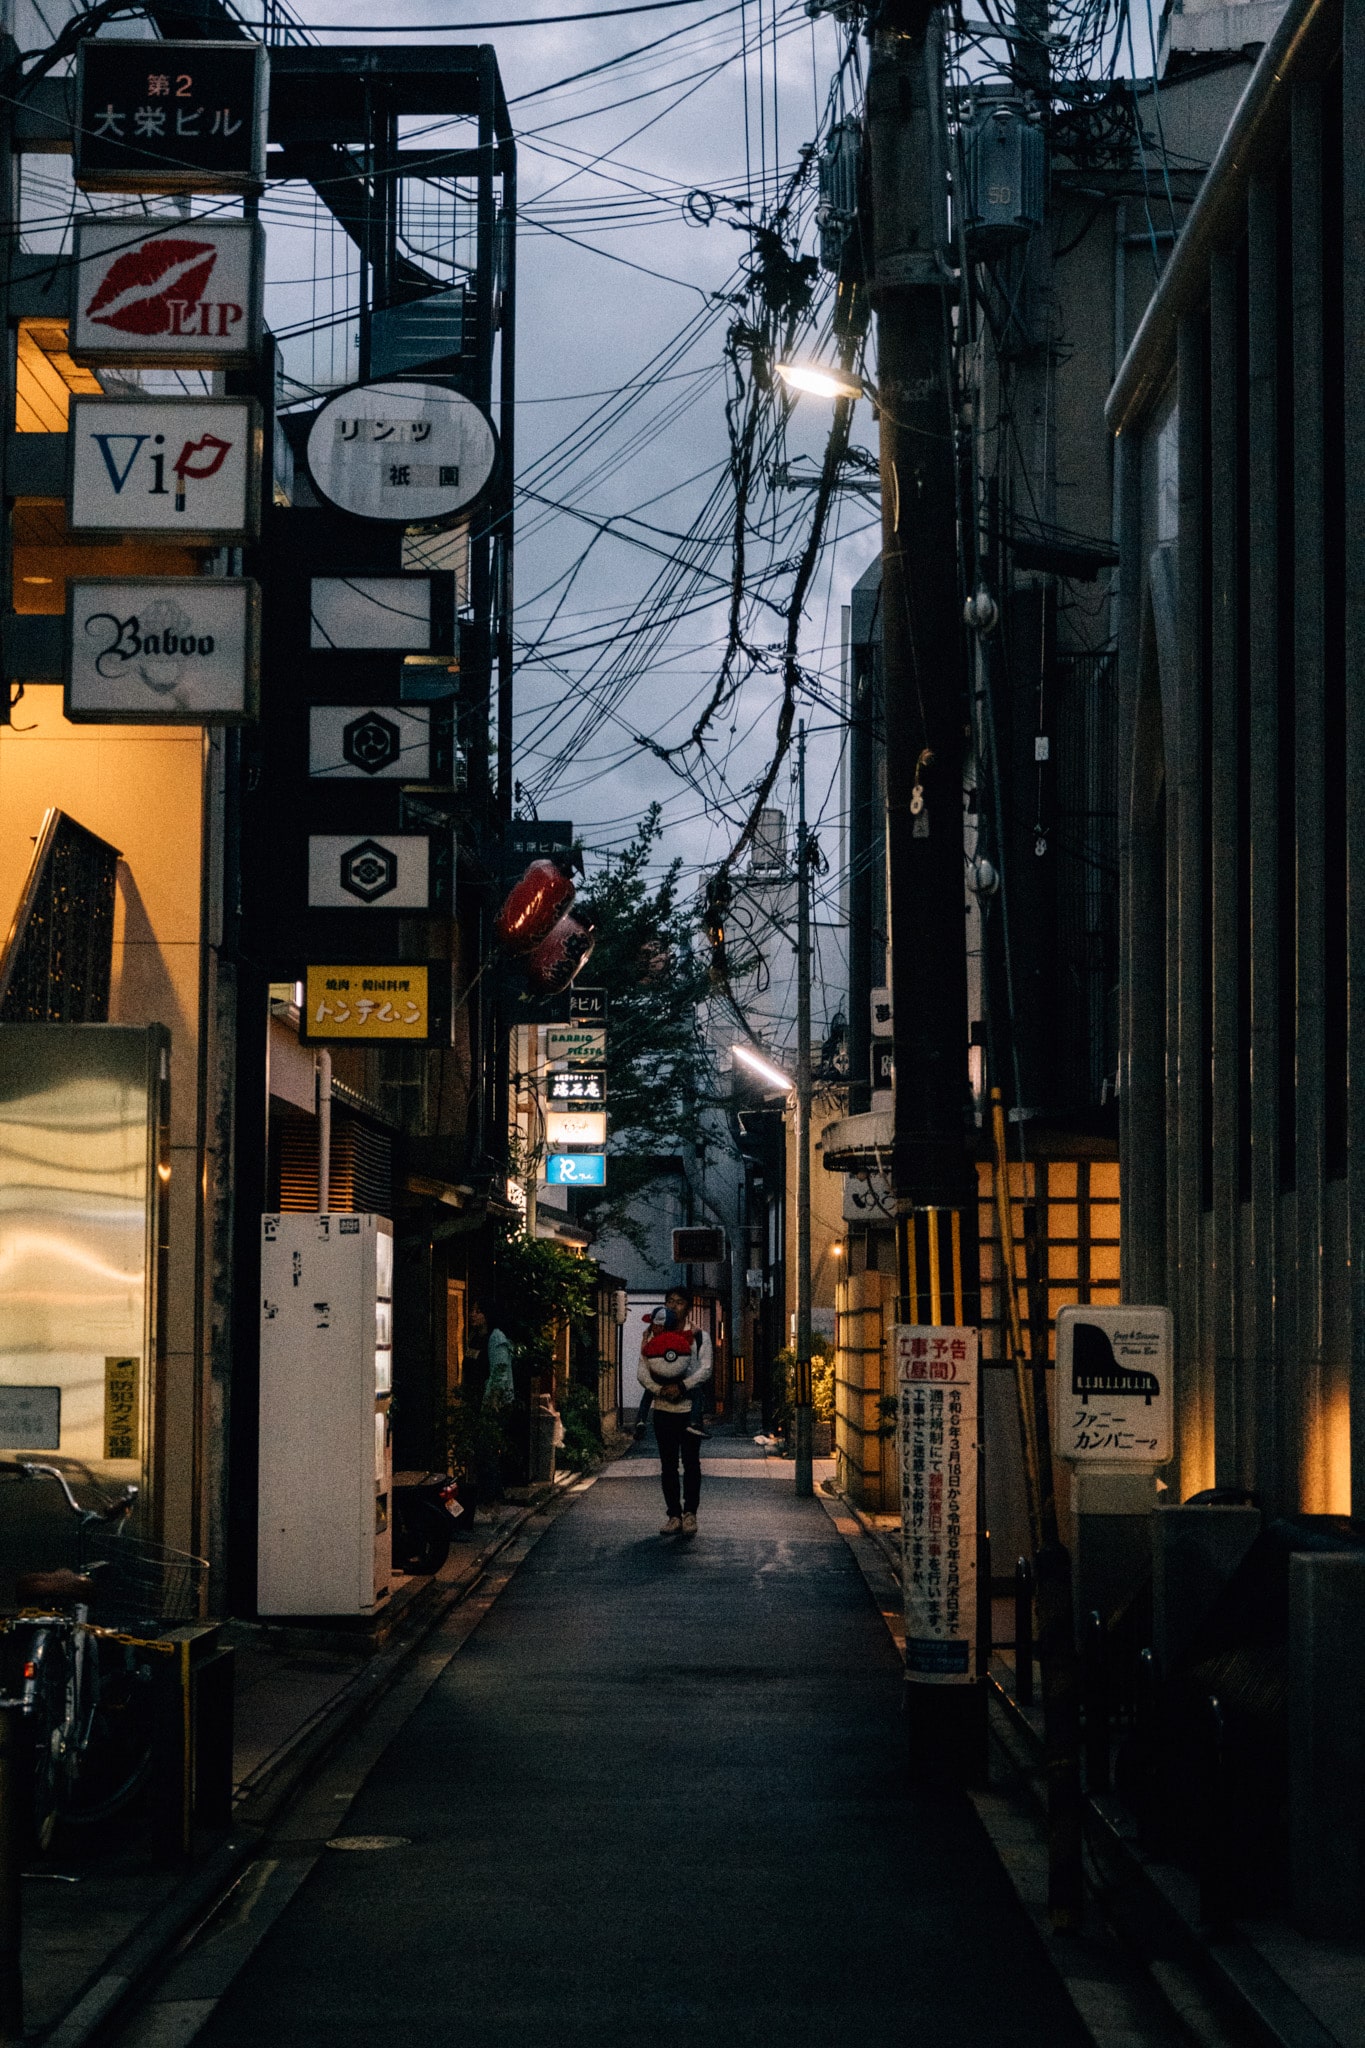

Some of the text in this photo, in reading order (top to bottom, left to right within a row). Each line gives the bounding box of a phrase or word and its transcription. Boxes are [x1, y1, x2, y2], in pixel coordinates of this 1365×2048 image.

[147, 73, 193, 97] 第2
[93, 103, 242, 137] 大栄ビル
[168, 301, 243, 336] LIP
[341, 420, 432, 441] リンツ
[390, 465, 459, 487] 祇園
[85, 612, 214, 679] Baboo
[551, 1034, 593, 1043] BARRIO
[567, 1046, 603, 1056] FIESTA
[900, 1338, 966, 1360] 工事予告
[1072, 1412, 1127, 1428] ファニー
